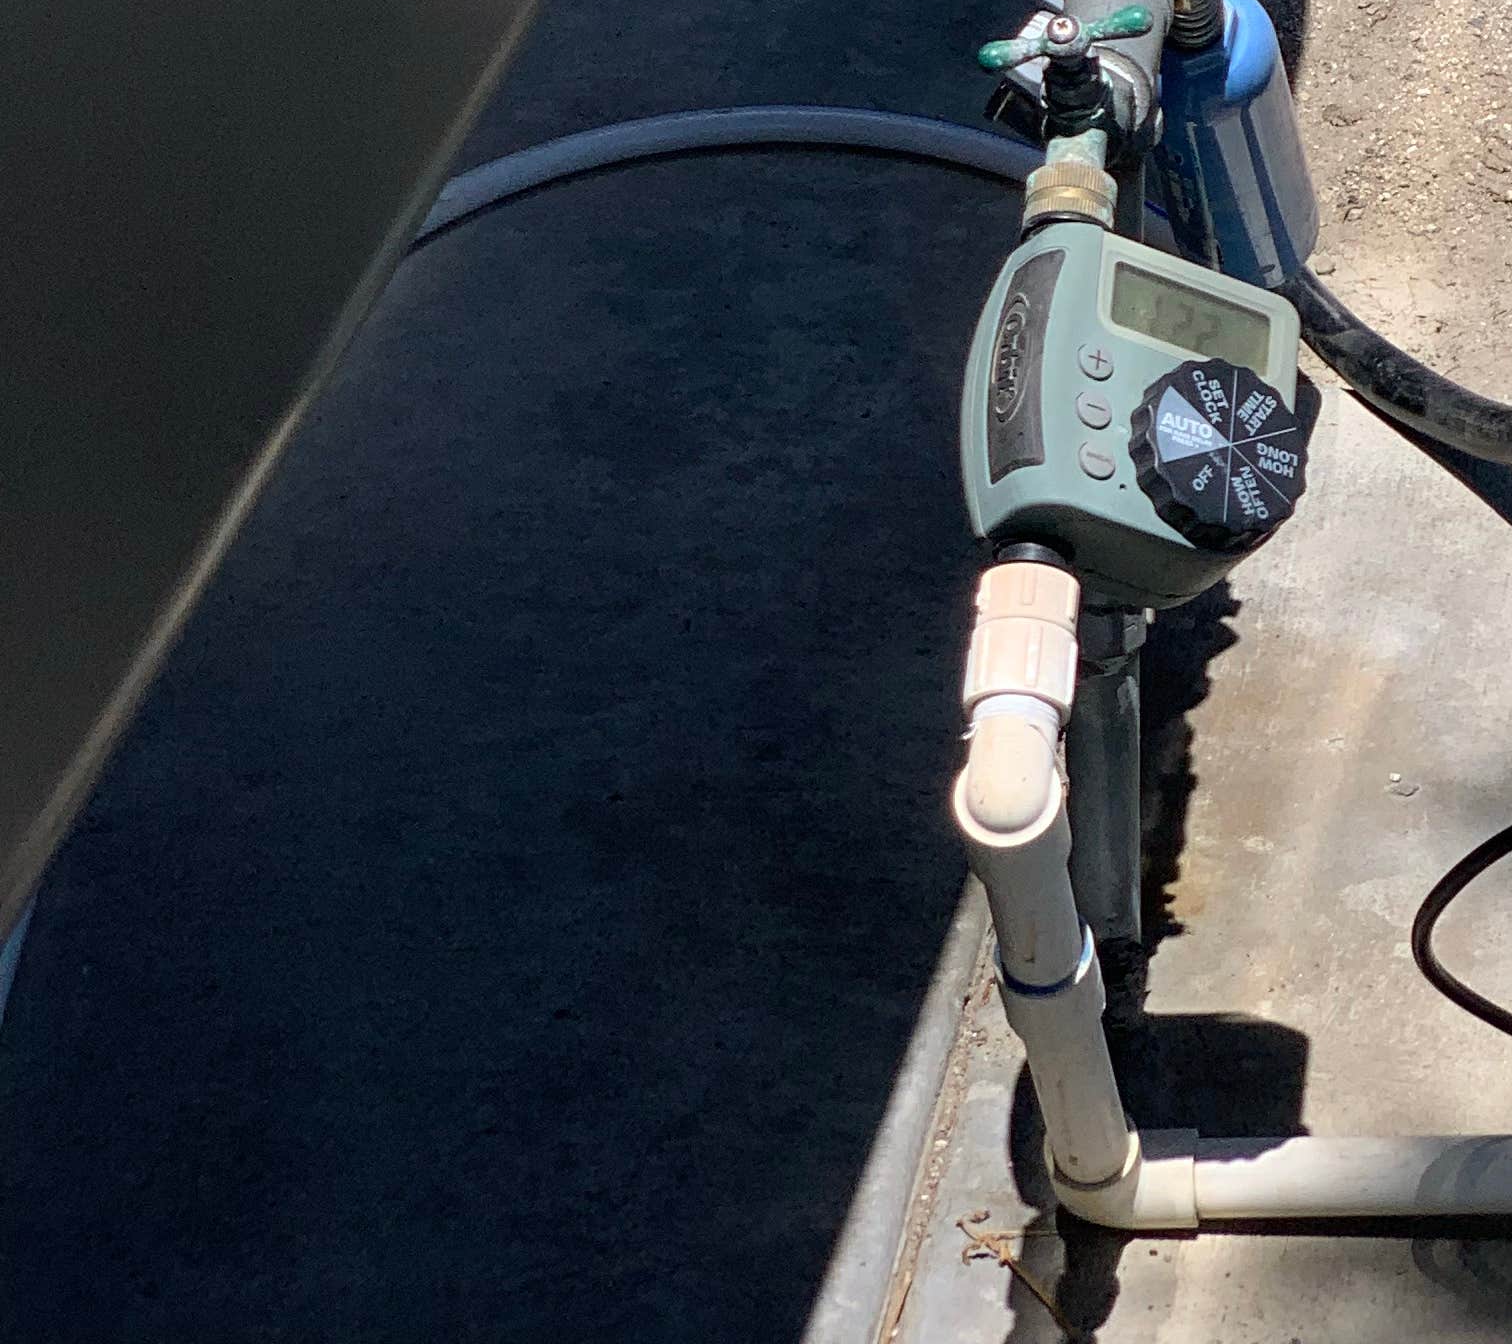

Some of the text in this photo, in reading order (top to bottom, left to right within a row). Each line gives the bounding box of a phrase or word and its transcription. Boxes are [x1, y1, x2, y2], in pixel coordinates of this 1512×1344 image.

[1192, 370, 1223, 424] CLOCK
[1208, 379, 1229, 409] SET
[1236, 390, 1264, 422] TIME
[1161, 412, 1212, 439] AUTO
[1245, 395, 1277, 435] START
[1256, 442, 1299, 466] LONG
[1258, 456, 1294, 478] HOW
[1192, 464, 1213, 491] OFF
[1239, 465, 1269, 520] OFTEN
[1231, 476, 1254, 515] HOW
